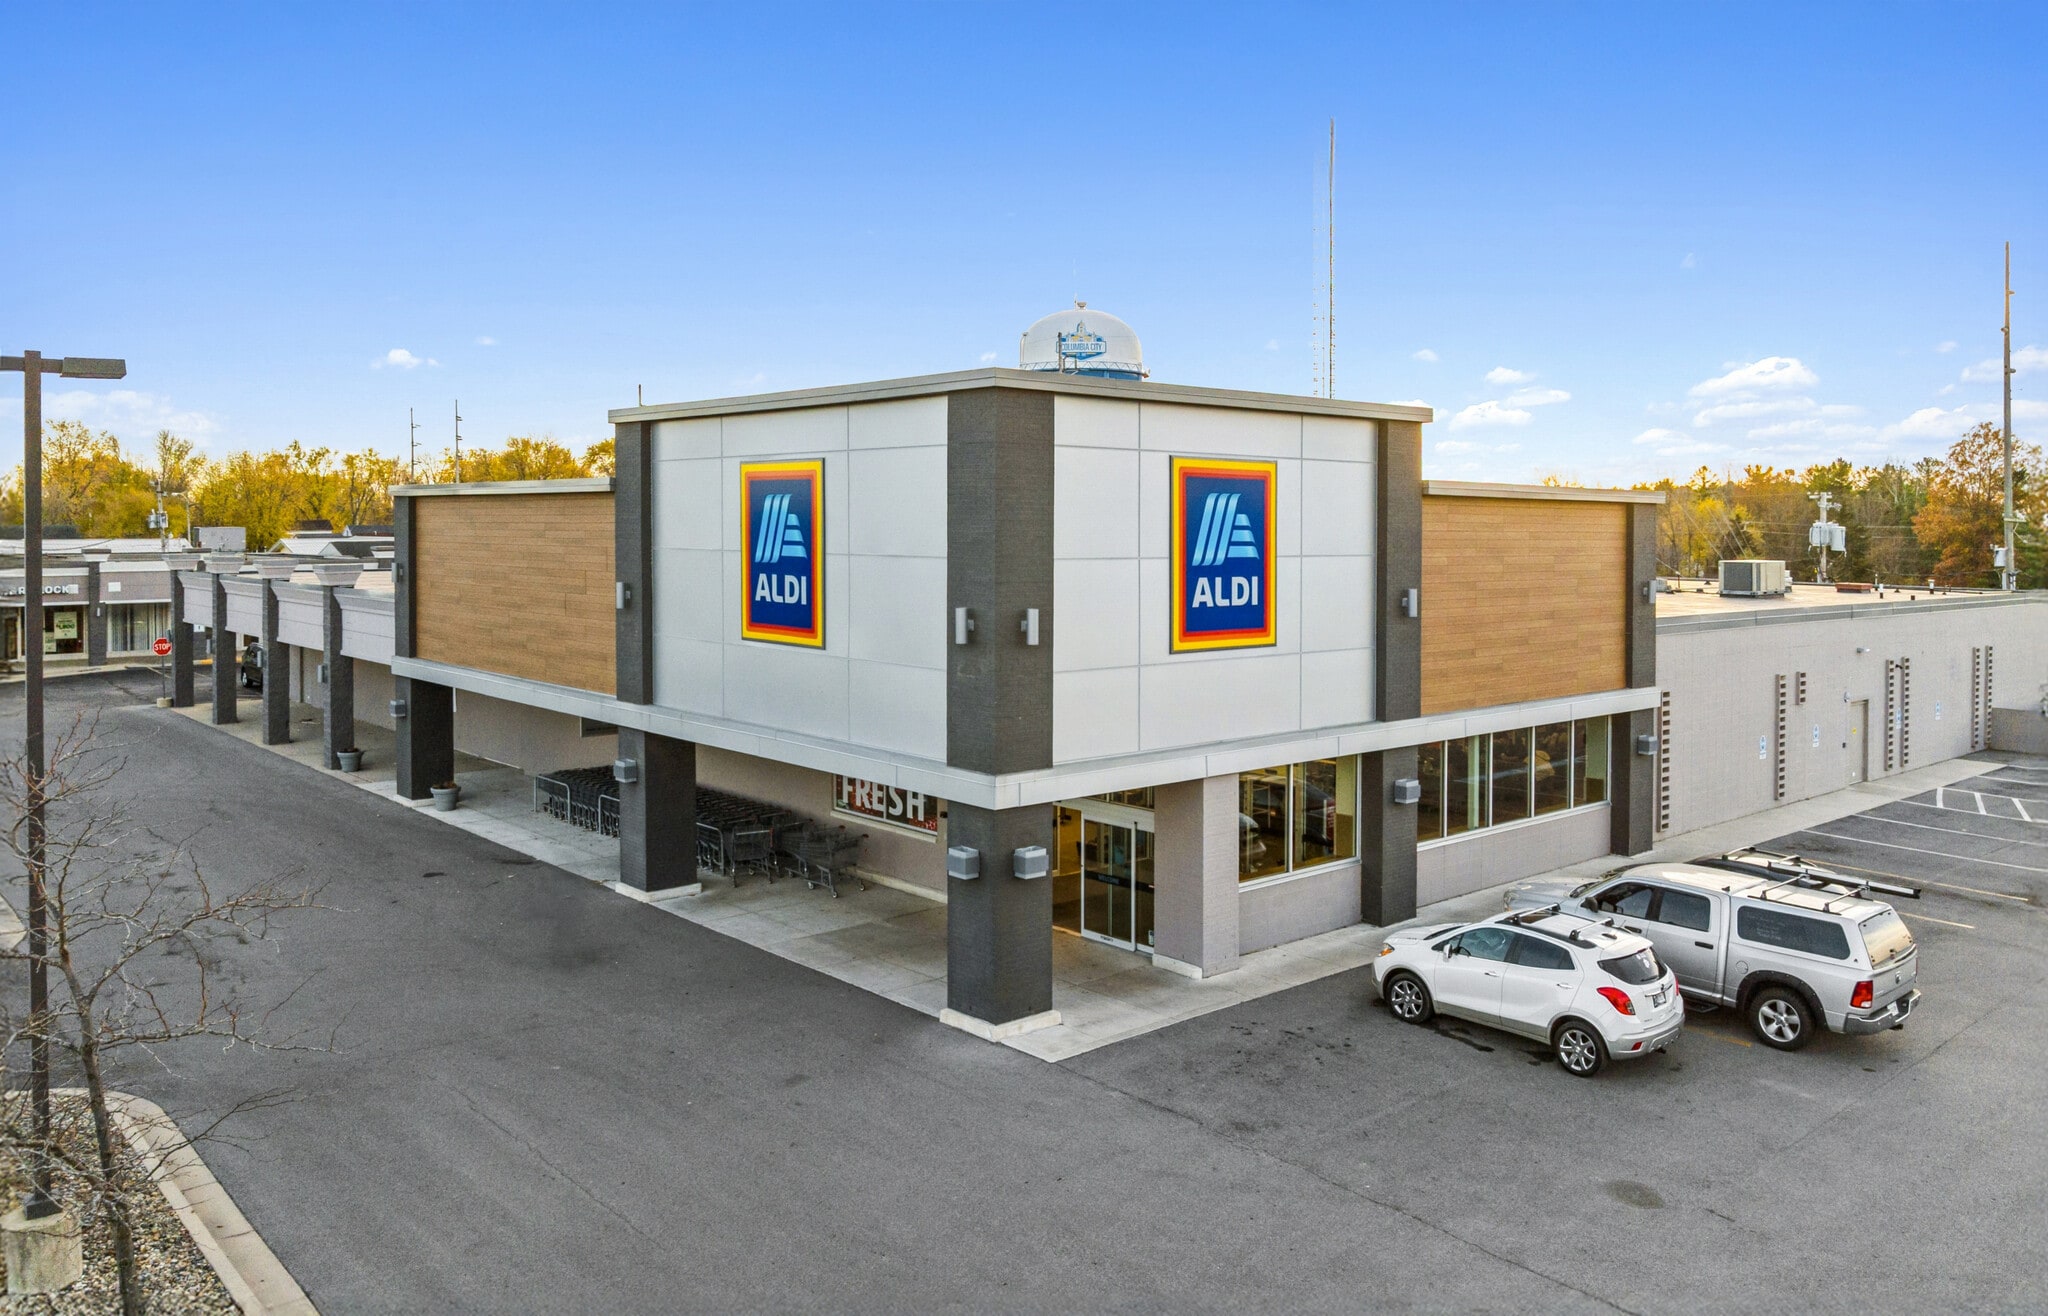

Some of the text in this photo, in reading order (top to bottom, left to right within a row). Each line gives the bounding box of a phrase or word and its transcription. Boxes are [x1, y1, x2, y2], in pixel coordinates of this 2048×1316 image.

[1061, 343, 1102, 351] COLUMBIA CITY
[755, 573, 807, 605] ALDI
[1192, 576, 1258, 608] ALDI
[154, 643, 171, 651] STOP
[842, 776, 925, 822] FRESH
